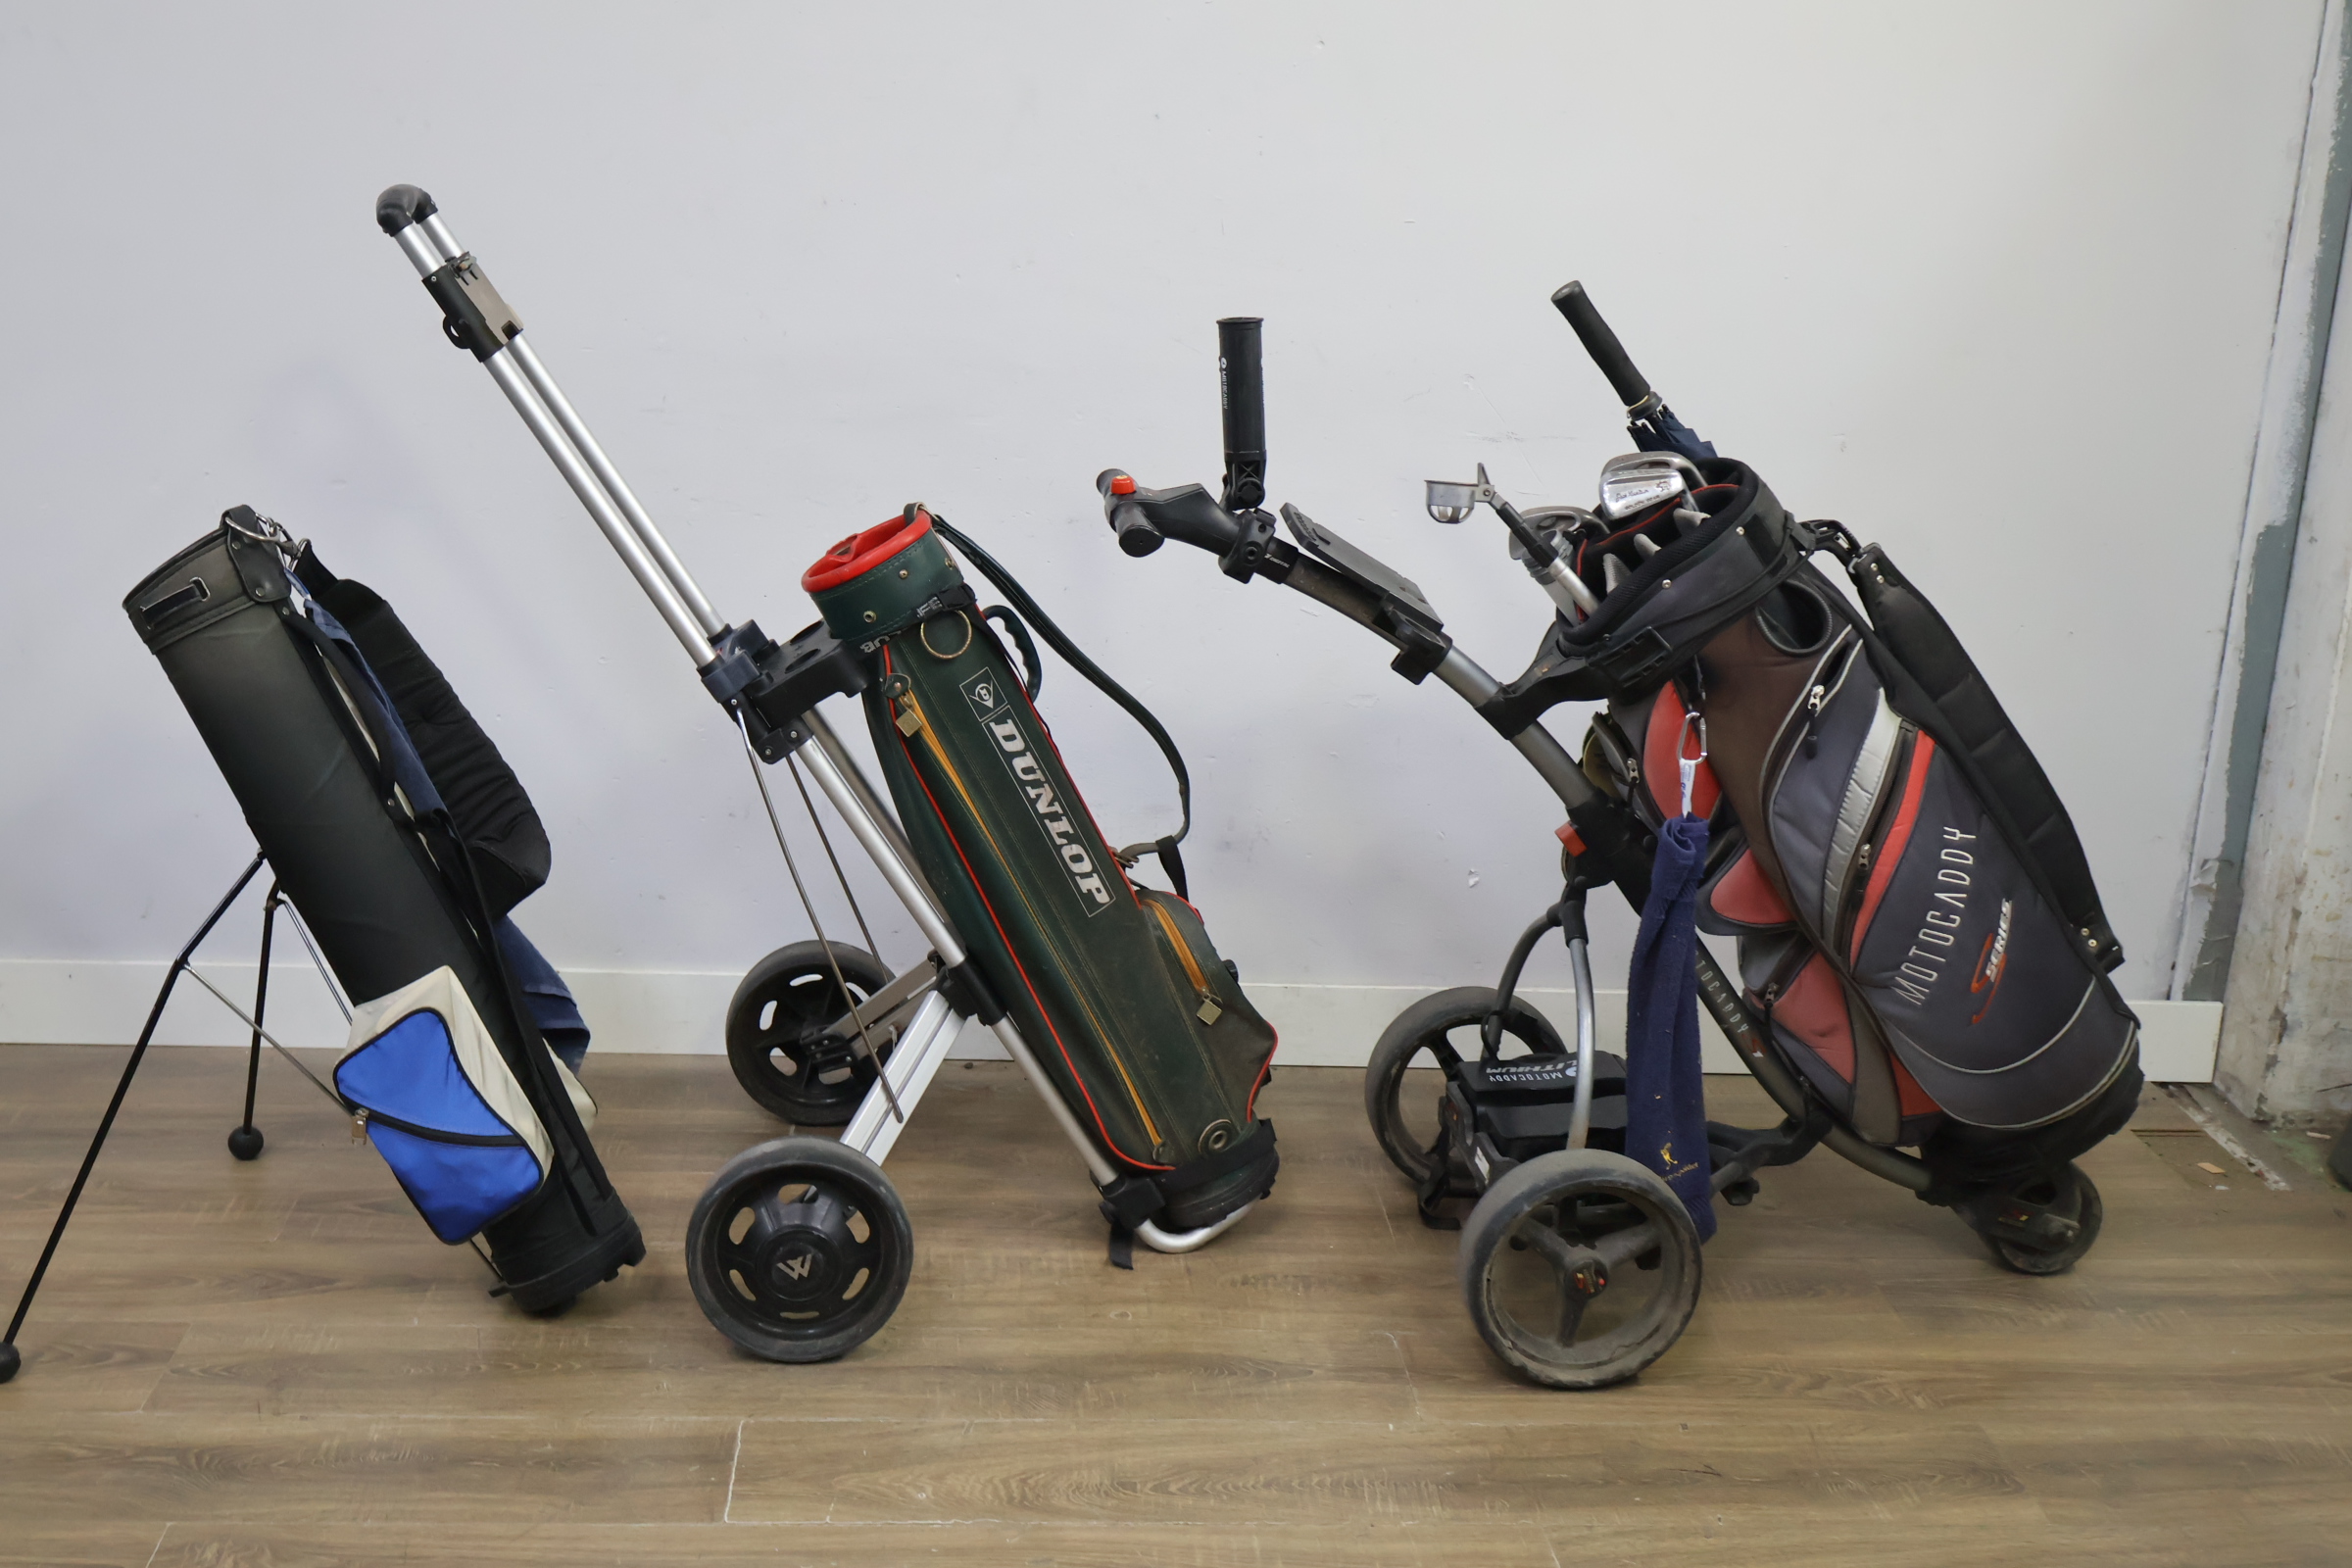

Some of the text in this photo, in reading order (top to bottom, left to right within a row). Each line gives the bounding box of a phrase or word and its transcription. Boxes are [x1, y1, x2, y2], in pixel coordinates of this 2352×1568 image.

[989, 718, 1110, 905] DUNLOP
[1890, 825, 1977, 1005] MOTOCADDY
[1985, 898, 2013, 983] SERIES
[1486, 1059, 1578, 1074] LITHIUM
[1489, 1071, 1563, 1083] MOTOCADDY
